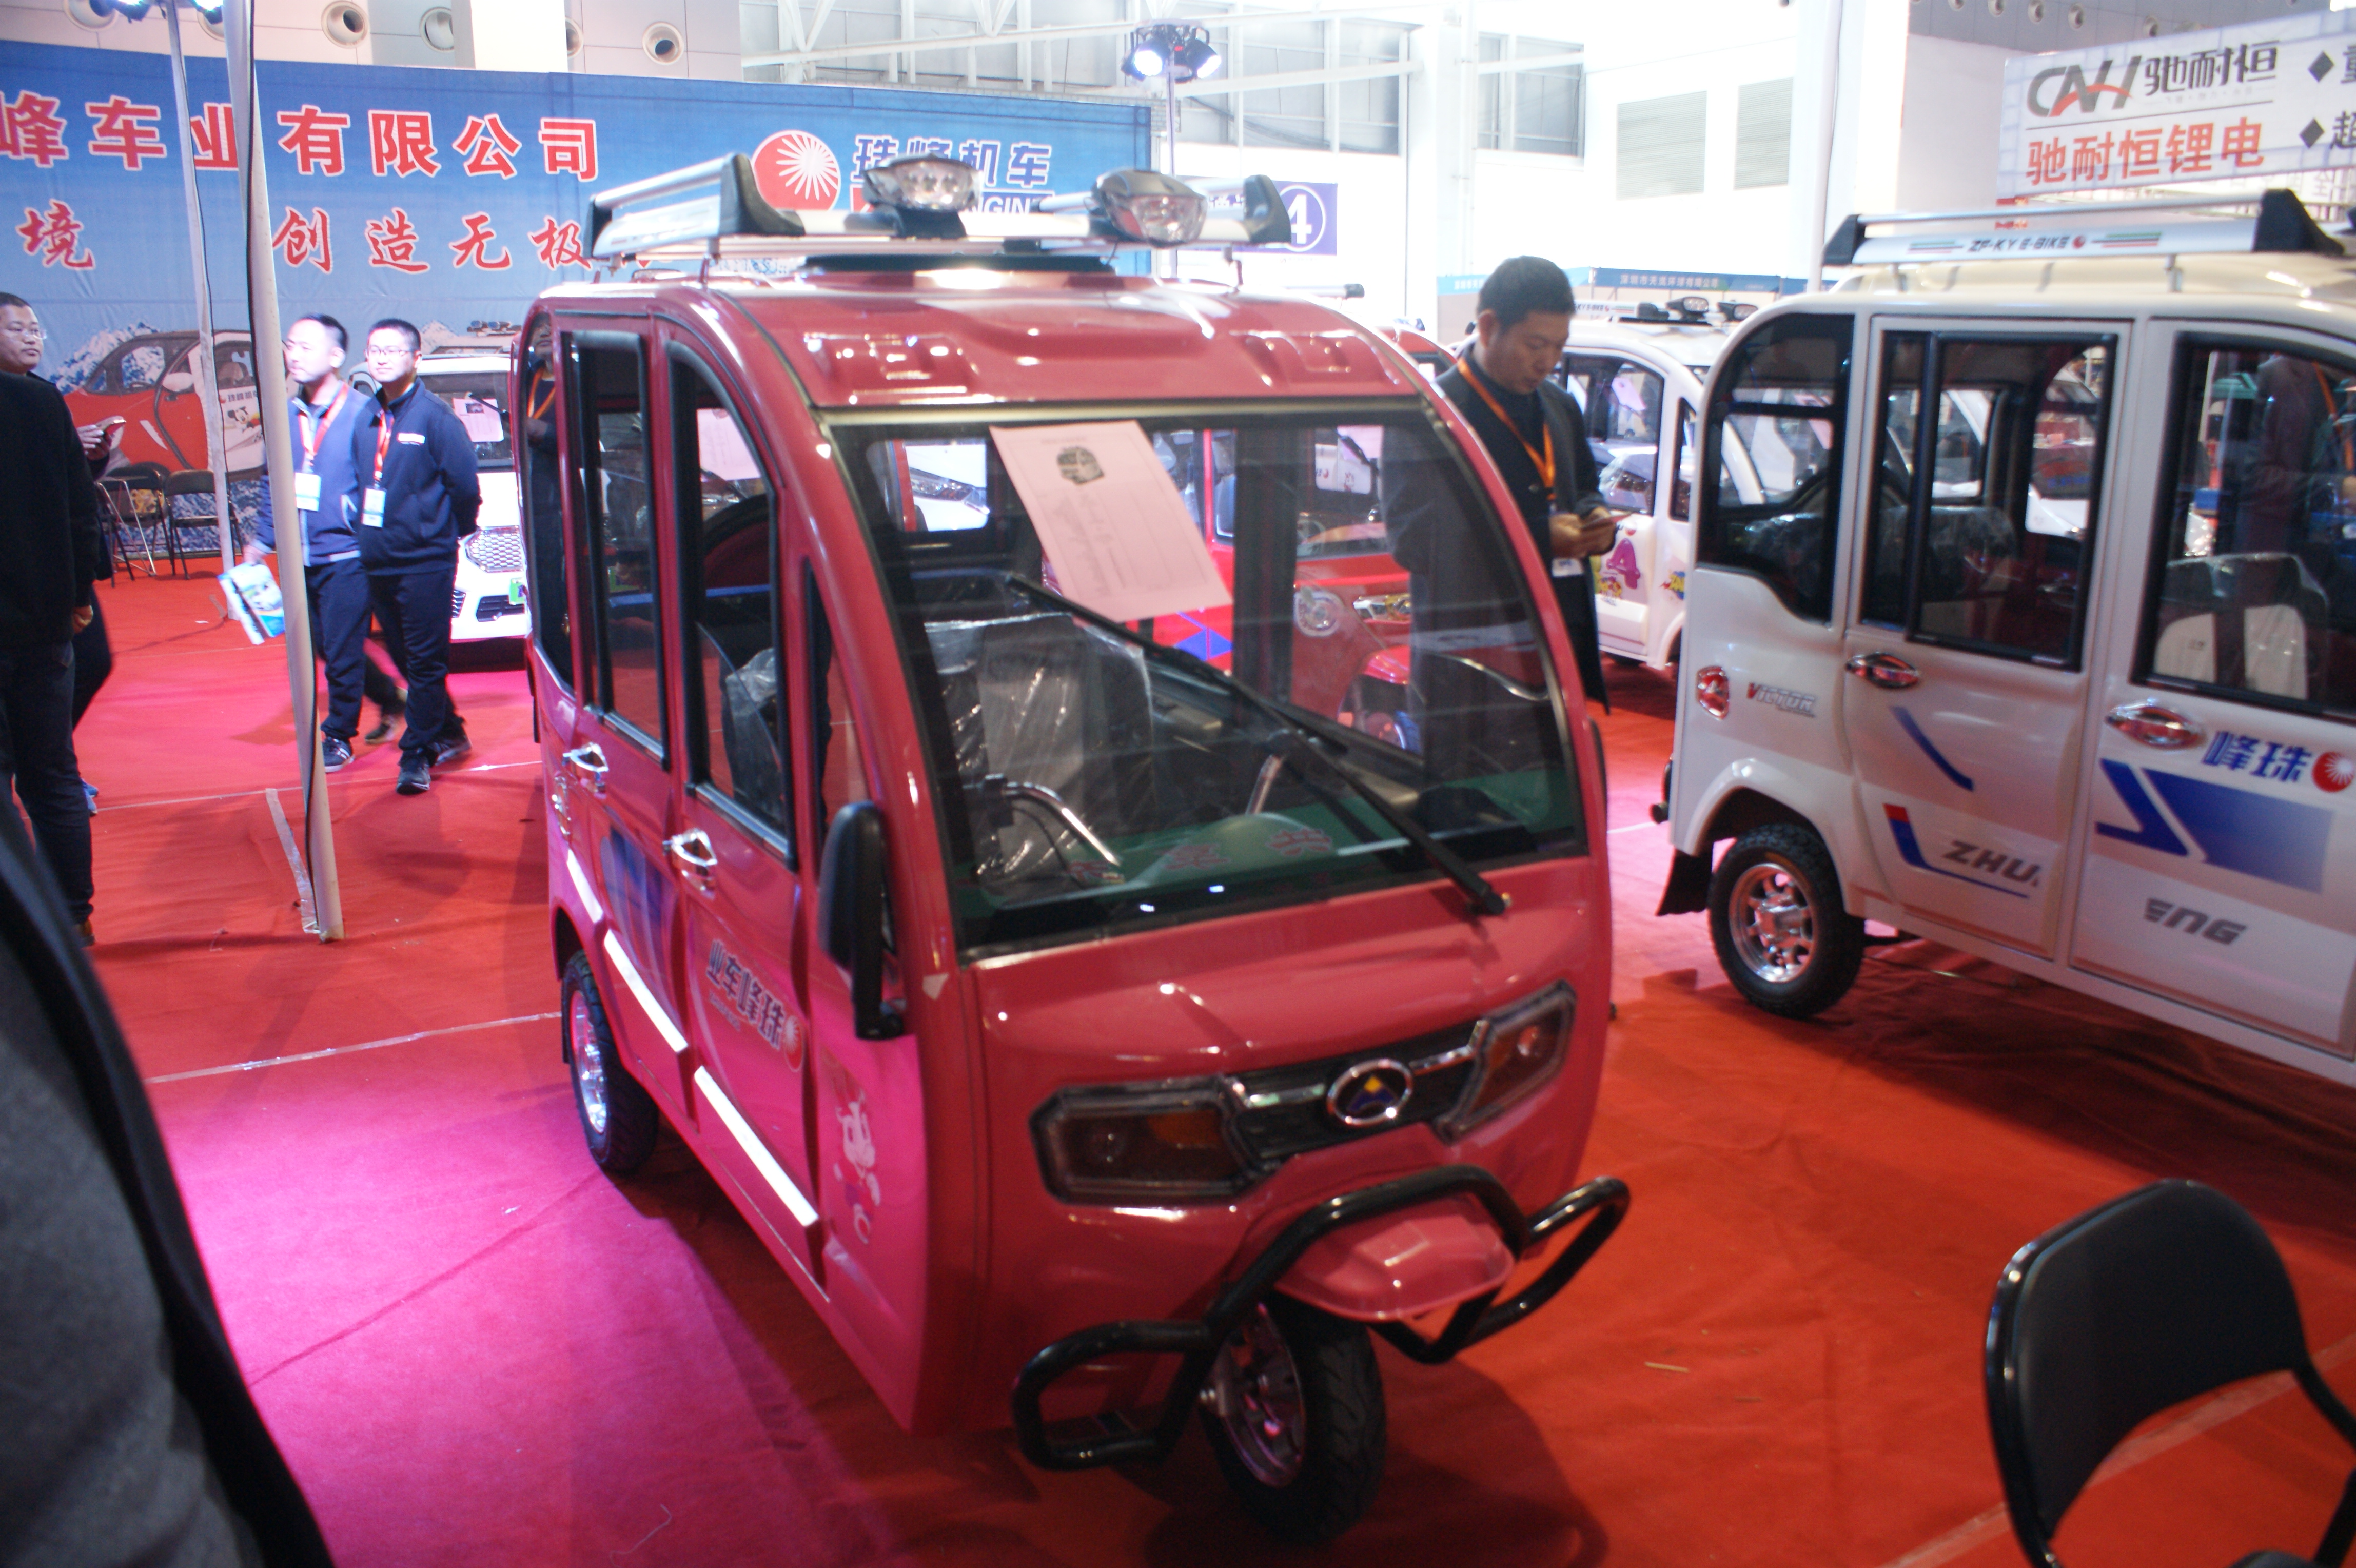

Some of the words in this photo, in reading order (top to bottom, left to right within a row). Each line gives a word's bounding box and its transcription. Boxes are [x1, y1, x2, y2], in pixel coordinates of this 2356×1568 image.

[2144, 40, 2280, 96] 驰耐恒
[2026, 117, 2264, 186] 驰耐恒锂电
[16, 199, 96, 270] 境
[272, 206, 662, 273] 创造无极
